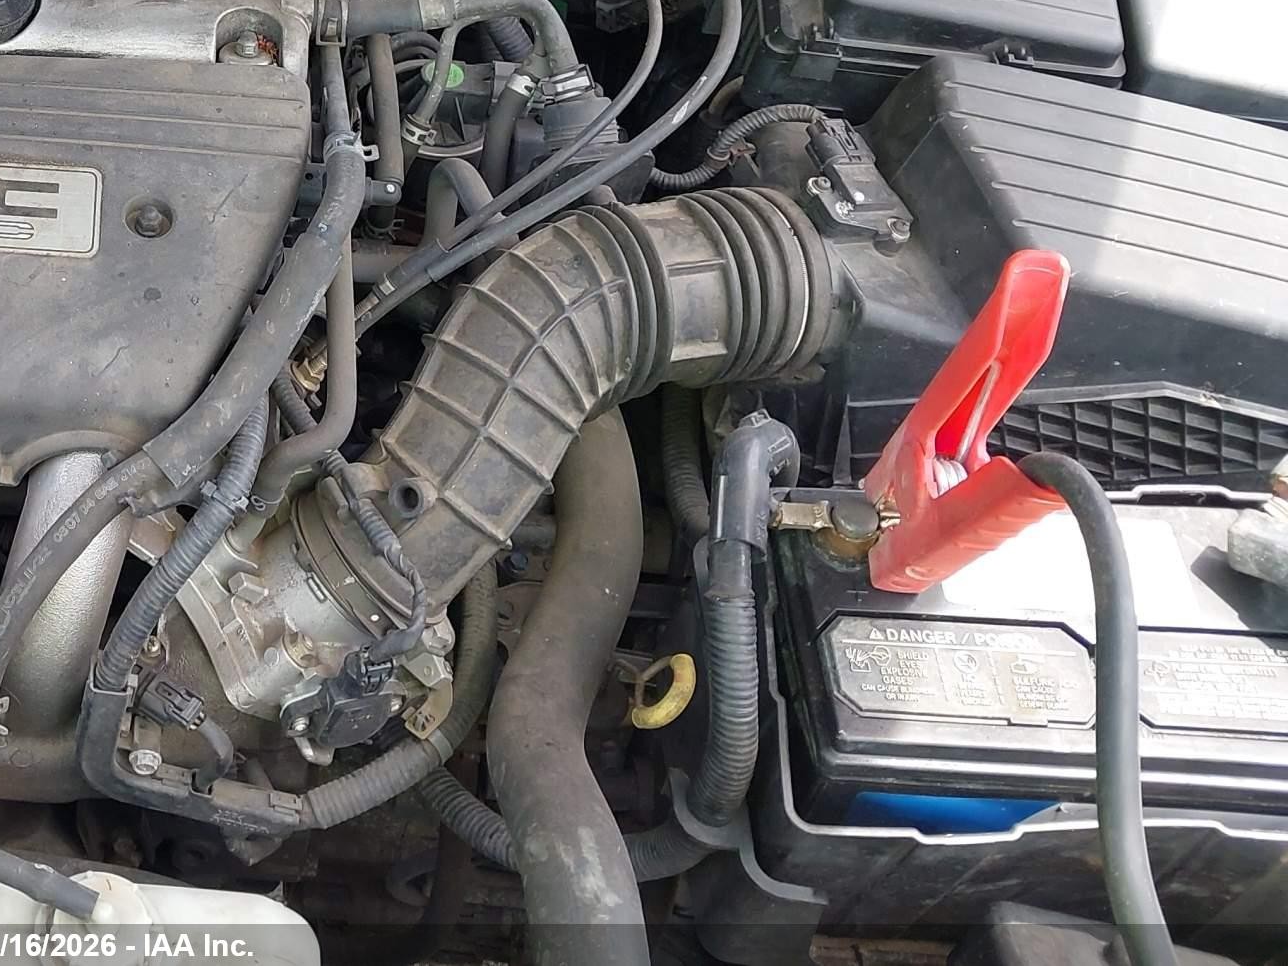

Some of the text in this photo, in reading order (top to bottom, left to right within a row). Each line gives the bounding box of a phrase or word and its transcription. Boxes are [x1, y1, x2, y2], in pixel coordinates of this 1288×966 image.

[886, 628, 957, 645] DANGER
[897, 651, 929, 660] SHIELD
[899, 660, 921, 669] EYES
[880, 667, 929, 677] EXPLOSIVE
[883, 676, 914, 685] GASES
[861, 683, 876, 691] CAN
